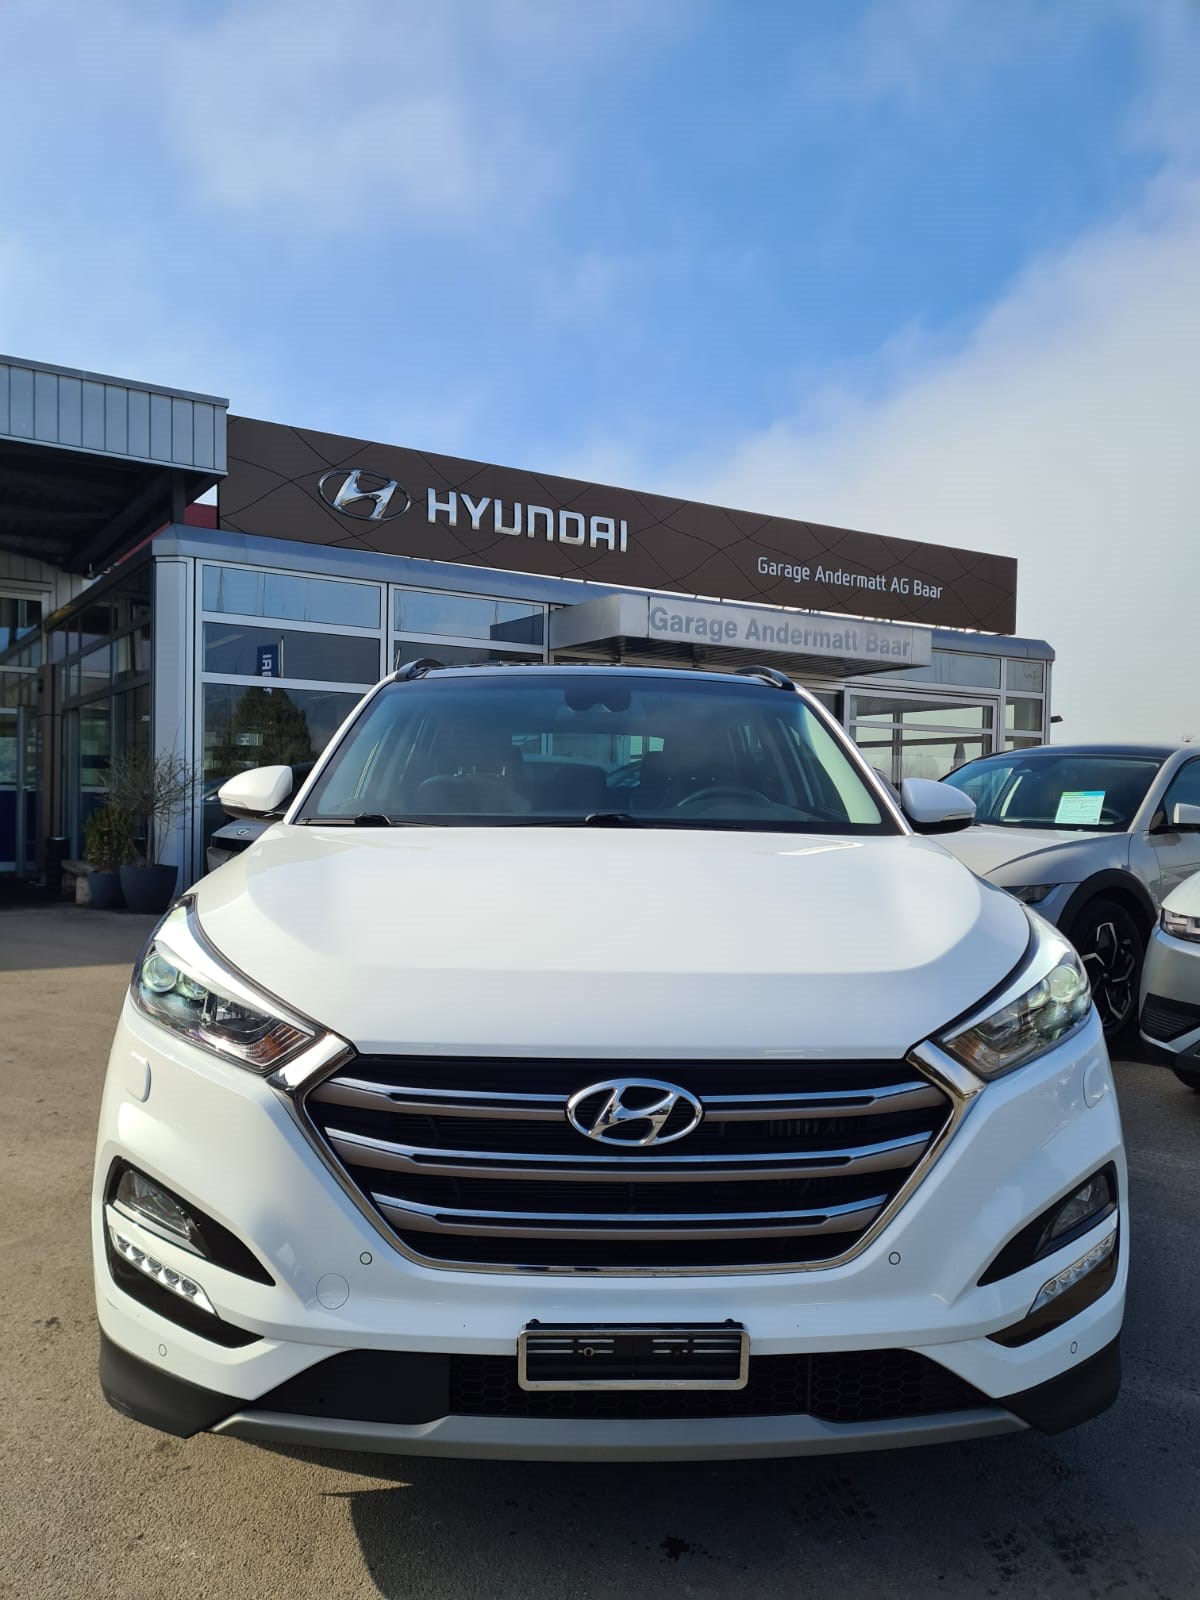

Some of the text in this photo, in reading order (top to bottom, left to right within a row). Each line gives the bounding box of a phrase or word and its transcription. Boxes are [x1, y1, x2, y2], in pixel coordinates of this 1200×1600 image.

[427, 487, 628, 552] HYUNDAI
[757, 556, 943, 599] Garage Andermatt AG Baar
[650, 606, 911, 657] Garage Andermatt Baar
